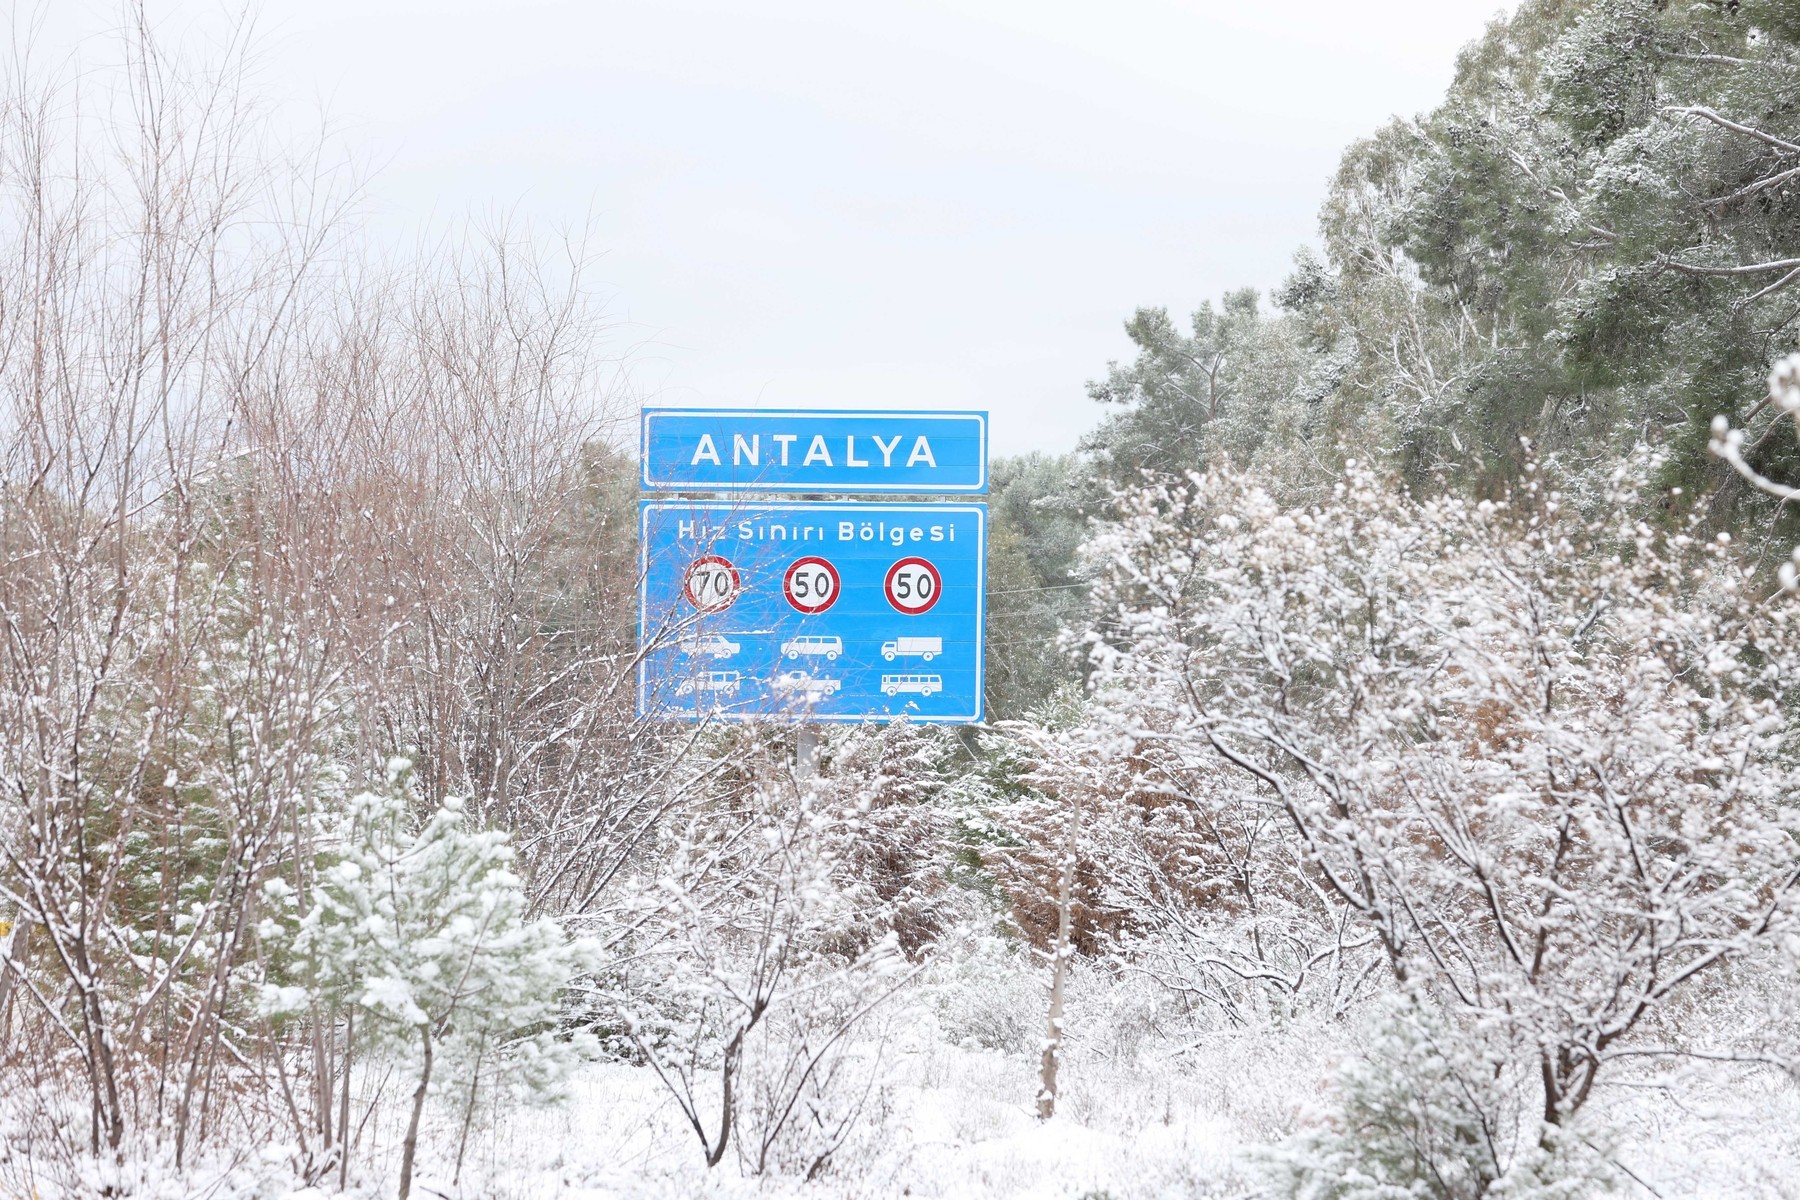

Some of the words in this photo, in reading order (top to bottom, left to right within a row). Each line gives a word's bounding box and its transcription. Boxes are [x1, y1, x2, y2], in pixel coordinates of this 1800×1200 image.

[691, 434, 937, 468] ANTALYA
[738, 521, 823, 541] Sınırı
[838, 521, 955, 546] Bölgesi
[694, 571, 729, 597] 70
[794, 572, 830, 598] 50
[896, 572, 932, 599] 50
